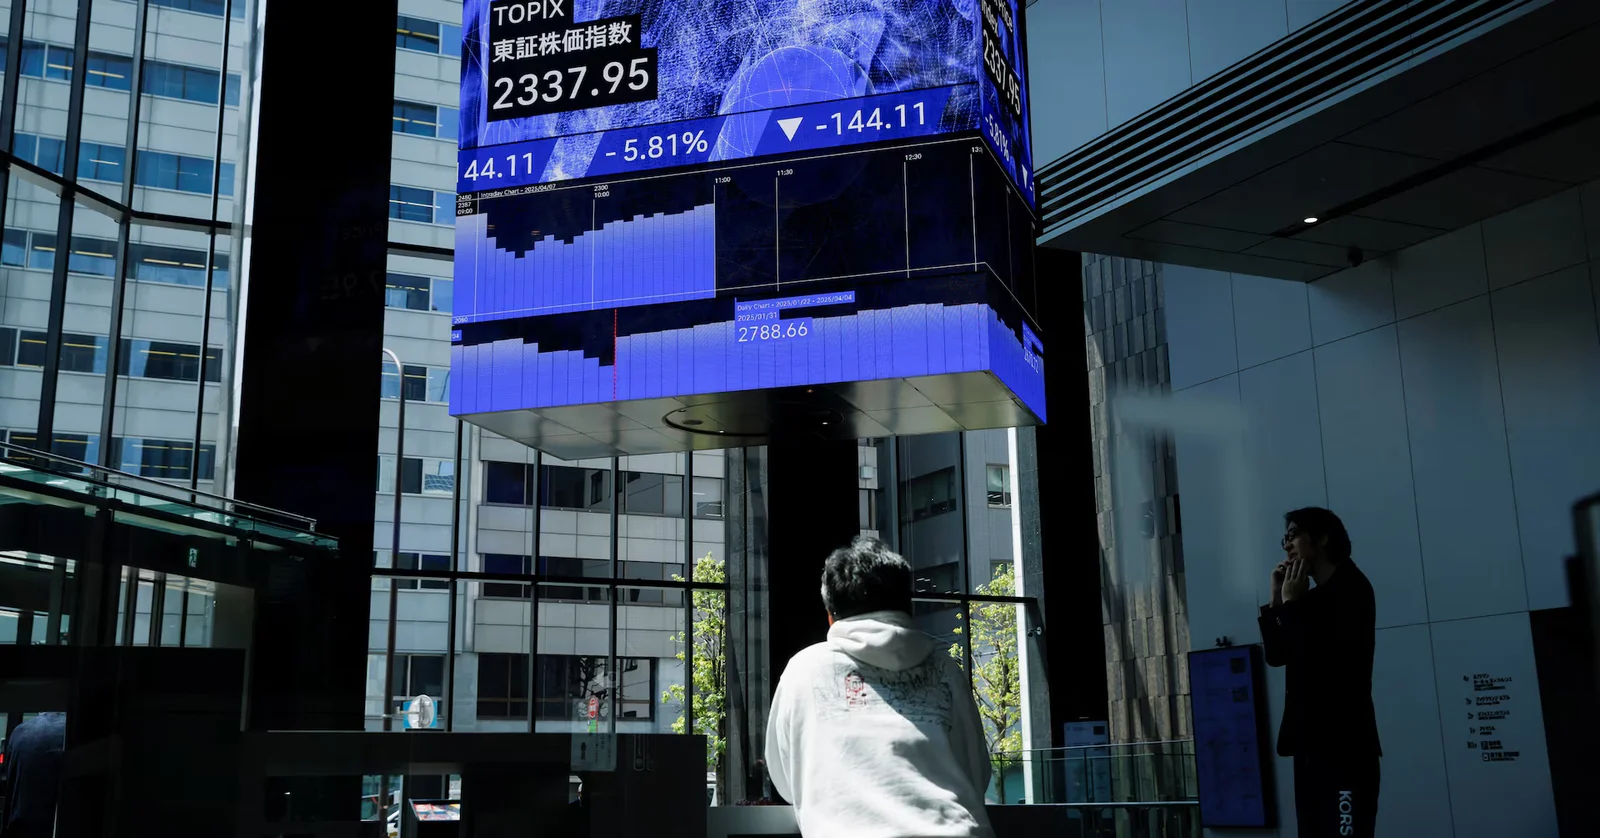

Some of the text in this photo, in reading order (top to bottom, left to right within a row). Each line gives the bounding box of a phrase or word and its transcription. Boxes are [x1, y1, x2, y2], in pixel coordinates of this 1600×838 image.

[493, 0, 565, 26] TOPIX
[492, 21, 632, 63] 東証株価指数
[492, 57, 649, 110] 2337.95
[983, 29, 1021, 116] 2337.95
[816, 101, 925, 136] -144.11
[905, 152, 922, 161] 12:30
[714, 176, 731, 184] 11:00
[777, 168, 793, 176] 11:30
[480, 189, 503, 198] Intraday
[504, 188, 519, 196] Chart
[524, 183, 556, 193] 2025/04/07
[737, 304, 752, 312] Daily
[737, 312, 777, 322] 2025/01/31
[738, 321, 808, 343] 2788.66
[1339, 790, 1353, 836] KORS
